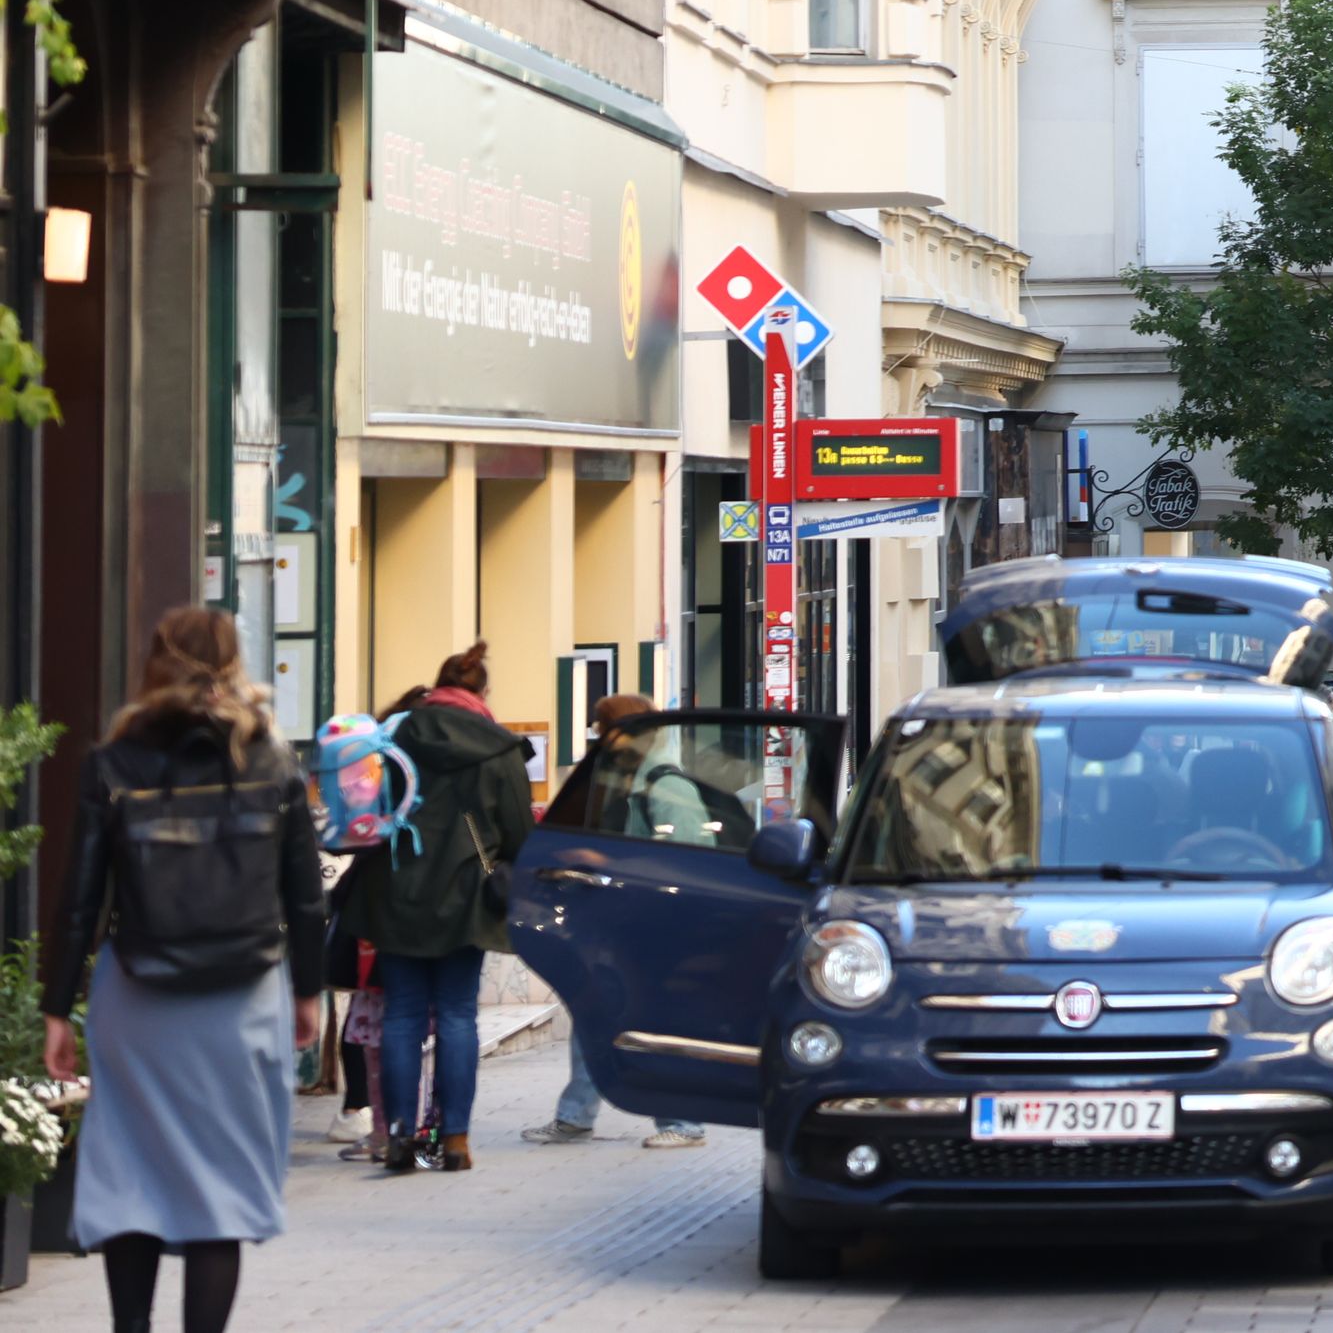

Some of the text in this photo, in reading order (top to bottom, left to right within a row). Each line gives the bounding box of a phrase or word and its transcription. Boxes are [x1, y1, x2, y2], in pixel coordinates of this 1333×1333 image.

[382, 249, 402, 313] Mit
[403, 254, 423, 316] der
[424, 259, 463, 336] Energie
[463, 268, 480, 325] der
[481, 271, 509, 331] Natur
[772, 373, 787, 429] WIENER
[772, 432, 786, 479] LINIEN
[1149, 469, 1196, 496] Tabak
[1150, 493, 1196, 520] Trafik
[767, 531, 791, 544] 13A
[767, 549, 790, 562] N71
[1045, 1102, 1138, 1129] 73970
